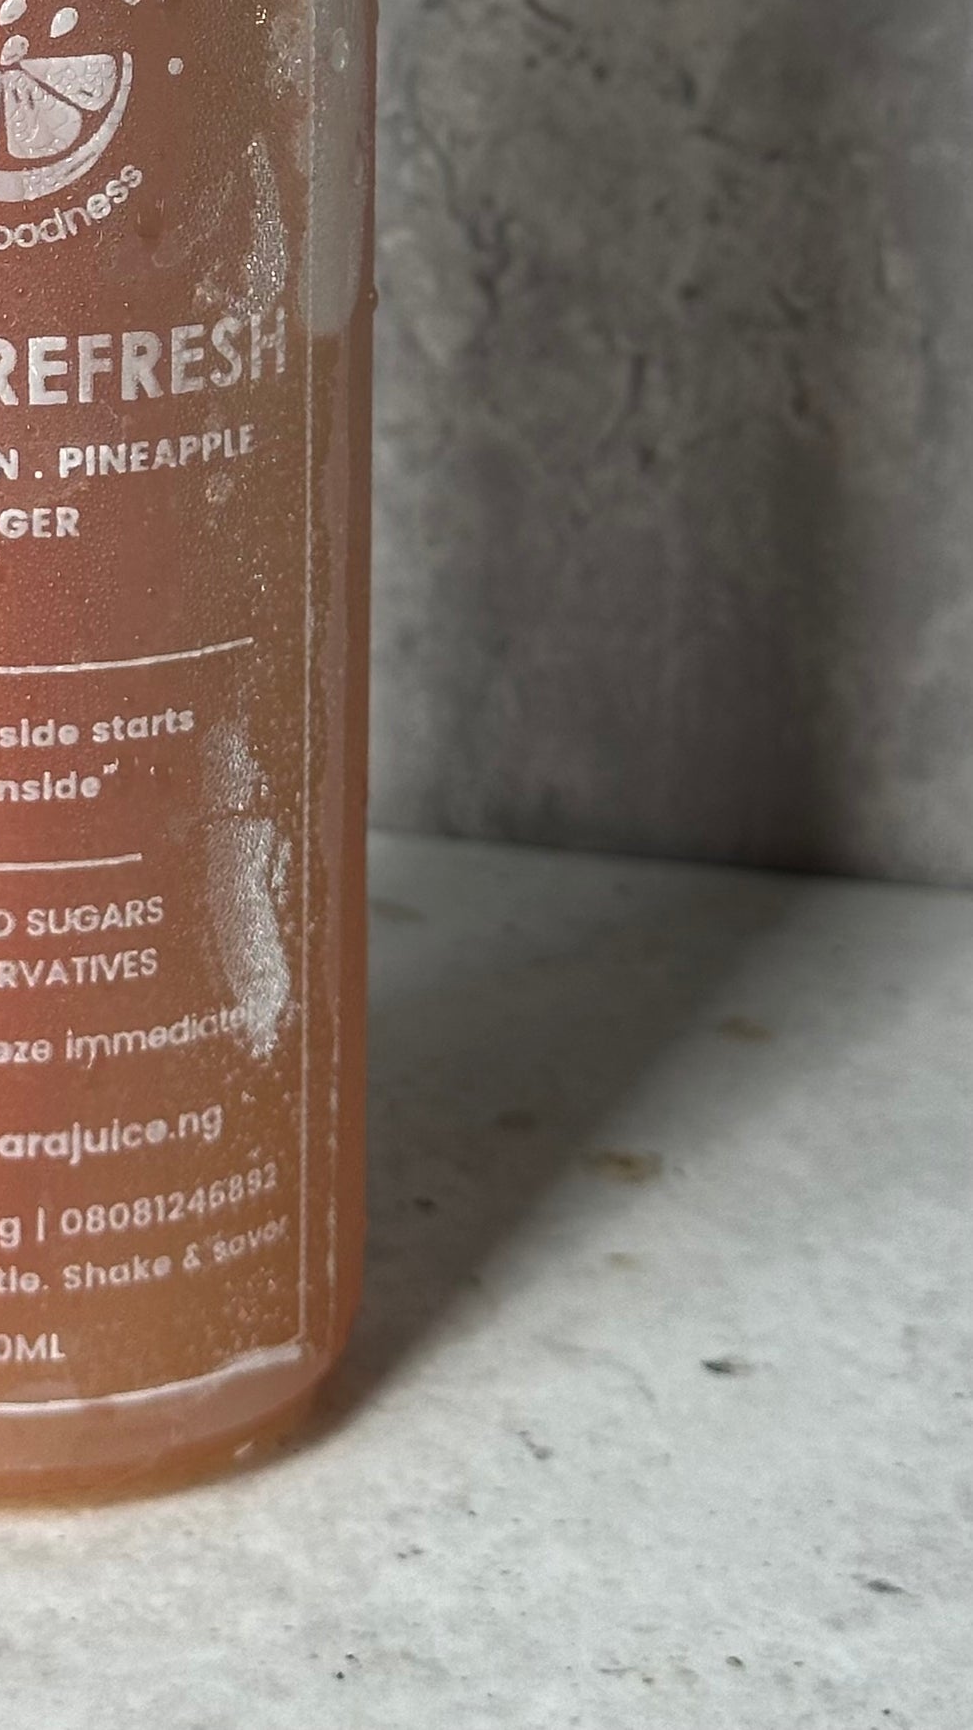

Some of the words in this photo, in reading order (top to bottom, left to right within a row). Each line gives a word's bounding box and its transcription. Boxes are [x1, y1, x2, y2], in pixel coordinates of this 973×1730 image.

[58, 424, 257, 480] PINEAPPLE
[92, 708, 195, 744] starts
[25, 895, 165, 937] SUGARS
[65, 998, 273, 1060] immediate
[61, 1254, 173, 1291] Shake
[182, 1241, 202, 1270] &
[212, 1214, 290, 1264] savor
